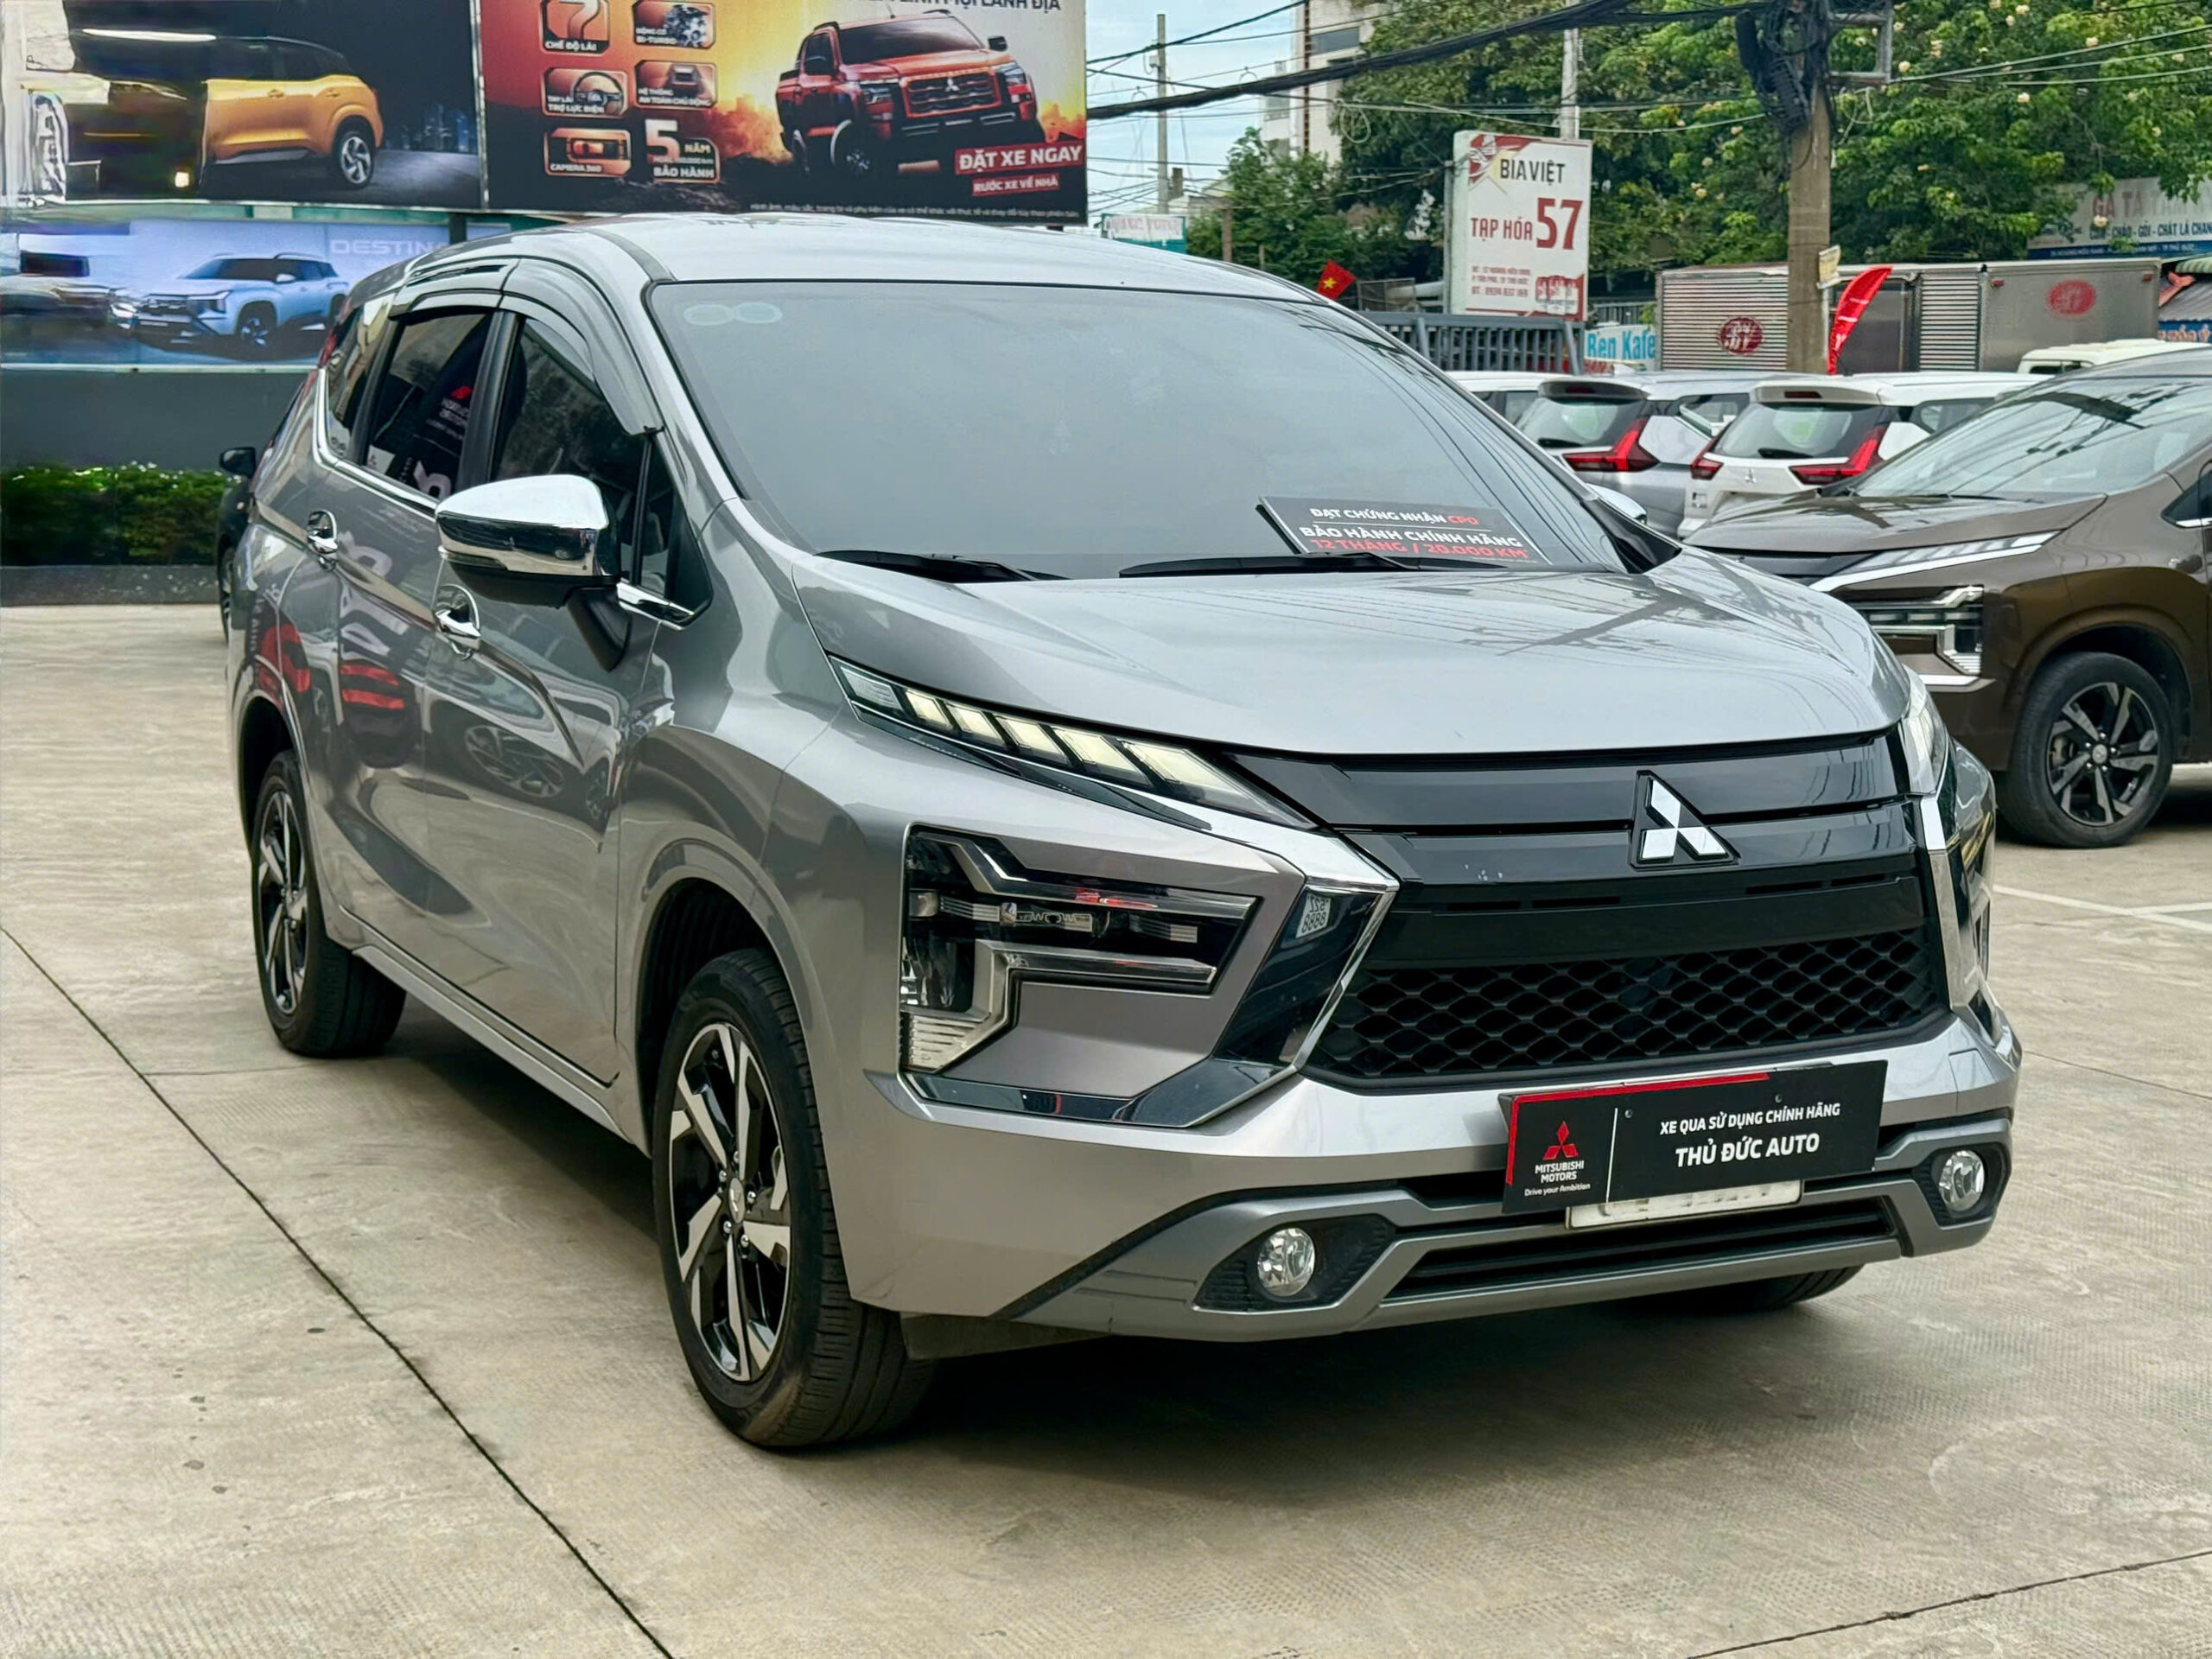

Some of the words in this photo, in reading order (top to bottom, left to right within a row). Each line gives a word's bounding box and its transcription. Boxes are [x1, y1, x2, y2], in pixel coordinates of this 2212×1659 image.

[558, 0, 600, 41] 7
[645, 118, 681, 163] 5
[684, 142, 711, 154] NĂM
[959, 149, 998, 173] ĐẶT
[1001, 149, 1027, 167] XE
[1031, 145, 1083, 164] NGAY
[653, 164, 678, 177] BẢO
[679, 166, 715, 178] HÀNH
[1004, 180, 1019, 189] XE
[1471, 217, 1499, 242] TẠP
[1503, 215, 1534, 241] HÓA
[1536, 197, 1583, 251] 57
[330, 239, 446, 256] DESTIN
[1309, 507, 1340, 519] ĐẠT
[1342, 508, 1401, 522] CHỨNG
[1402, 512, 1447, 524] NHẬN
[1299, 524, 1344, 539] BẢO
[1346, 526, 1404, 542] HÀNH
[1405, 528, 1466, 544] CHÍNH
[1469, 532, 1523, 548] HÃNG
[1336, 537, 1408, 553] THÁNG
[1423, 543, 1496, 558] 20.000
[1660, 1121, 1678, 1135] XE
[1679, 1116, 1707, 1135] QUA
[1708, 1111, 1727, 1130] SỬ
[1727, 1111, 1763, 1130] DỤNG
[1765, 1105, 1804, 1124] CHÍNH
[1806, 1102, 1841, 1120] HÃNG
[1675, 1137, 1717, 1167] THỦ
[1720, 1135, 1764, 1163] ĐỨC
[1764, 1133, 1821, 1158] AUTO
[1534, 1160, 1585, 1174] MITSUBISHI
[1540, 1171, 1578, 1184] MOTORS
[1524, 1188, 1543, 1197] Drive
[1543, 1186, 1559, 1197] your
[1559, 1182, 1592, 1193] Ambition
